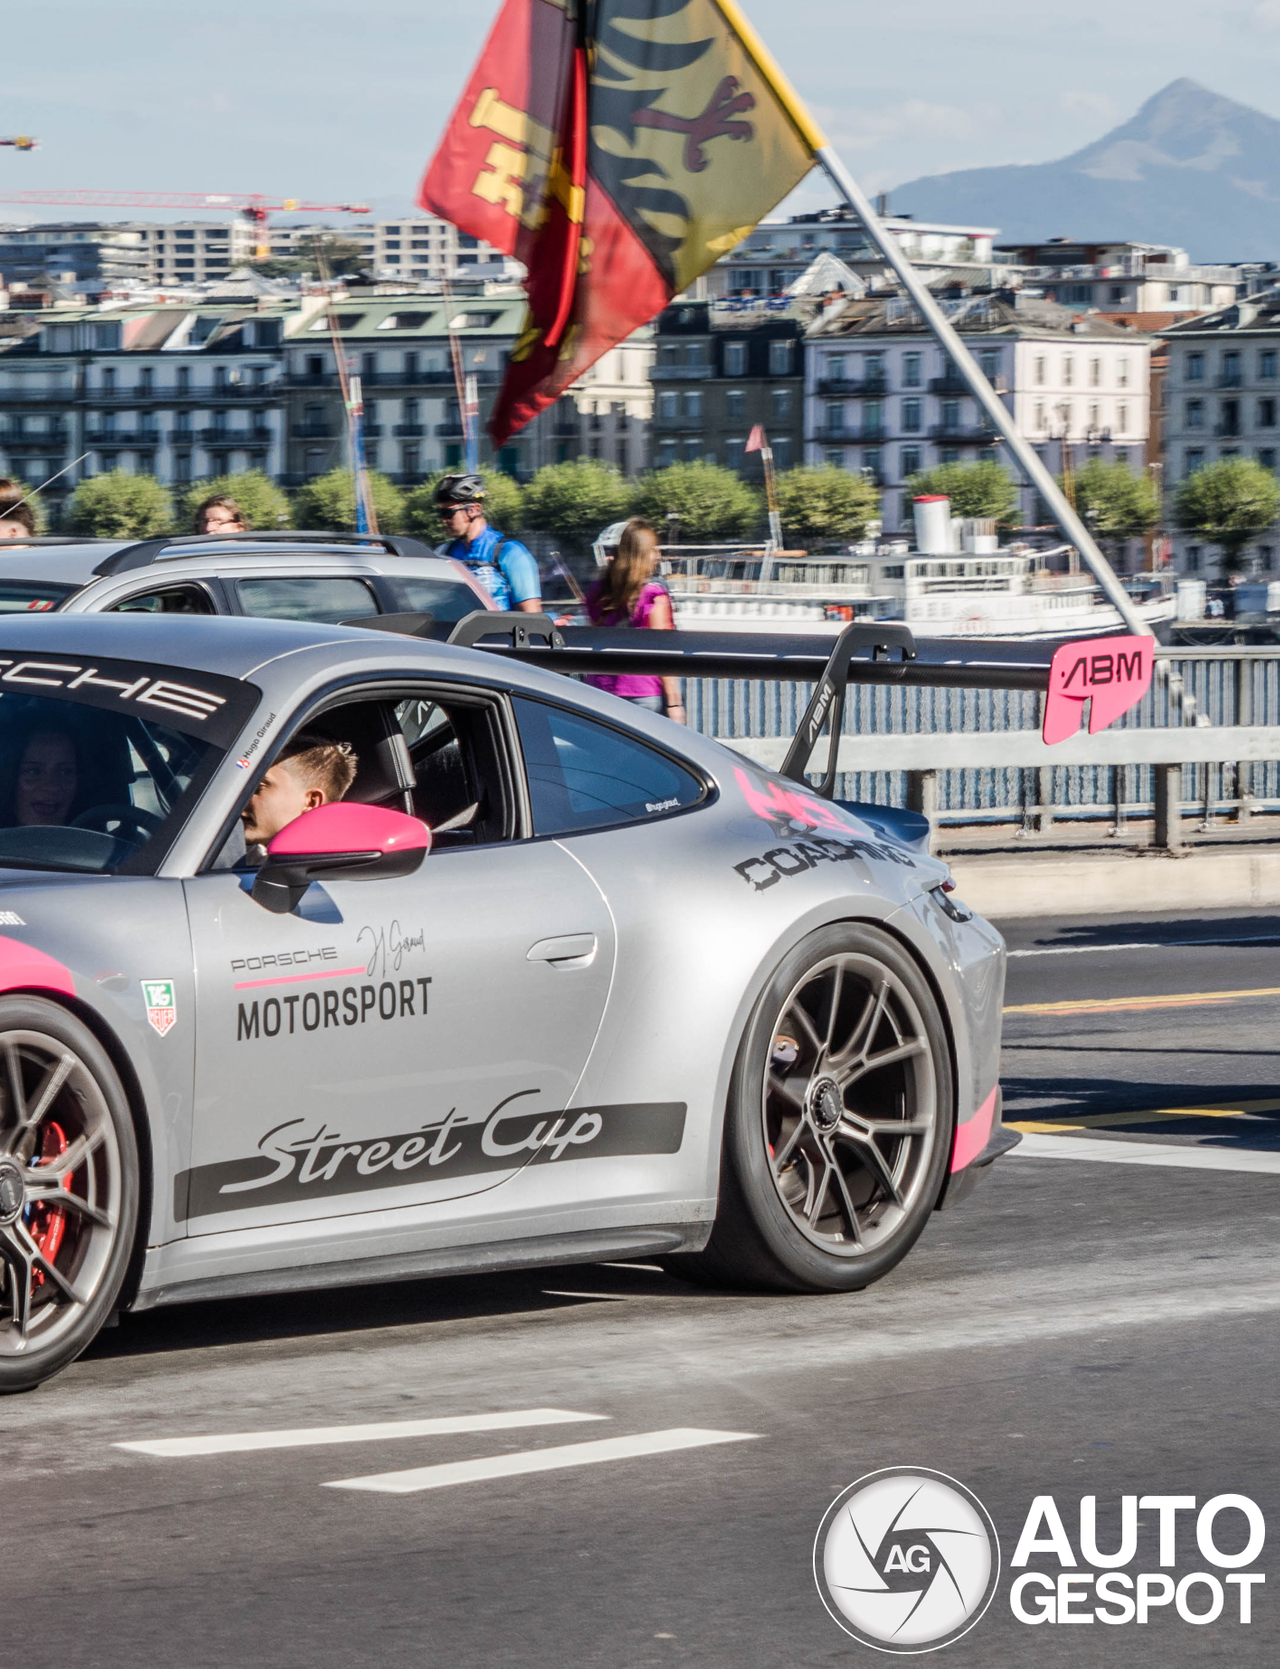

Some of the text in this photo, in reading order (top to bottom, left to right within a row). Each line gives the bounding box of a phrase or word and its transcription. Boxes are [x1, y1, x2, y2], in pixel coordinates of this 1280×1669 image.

[1062, 651, 1142, 689] ABM
[243, 712, 277, 759] Hugo Giraud
[809, 683, 832, 743] ABM
[733, 839, 917, 892] COACHING
[230, 947, 338, 972] PORSCHE
[237, 977, 432, 1041] MOTORSPORT
[219, 1089, 603, 1194] Street Cup
